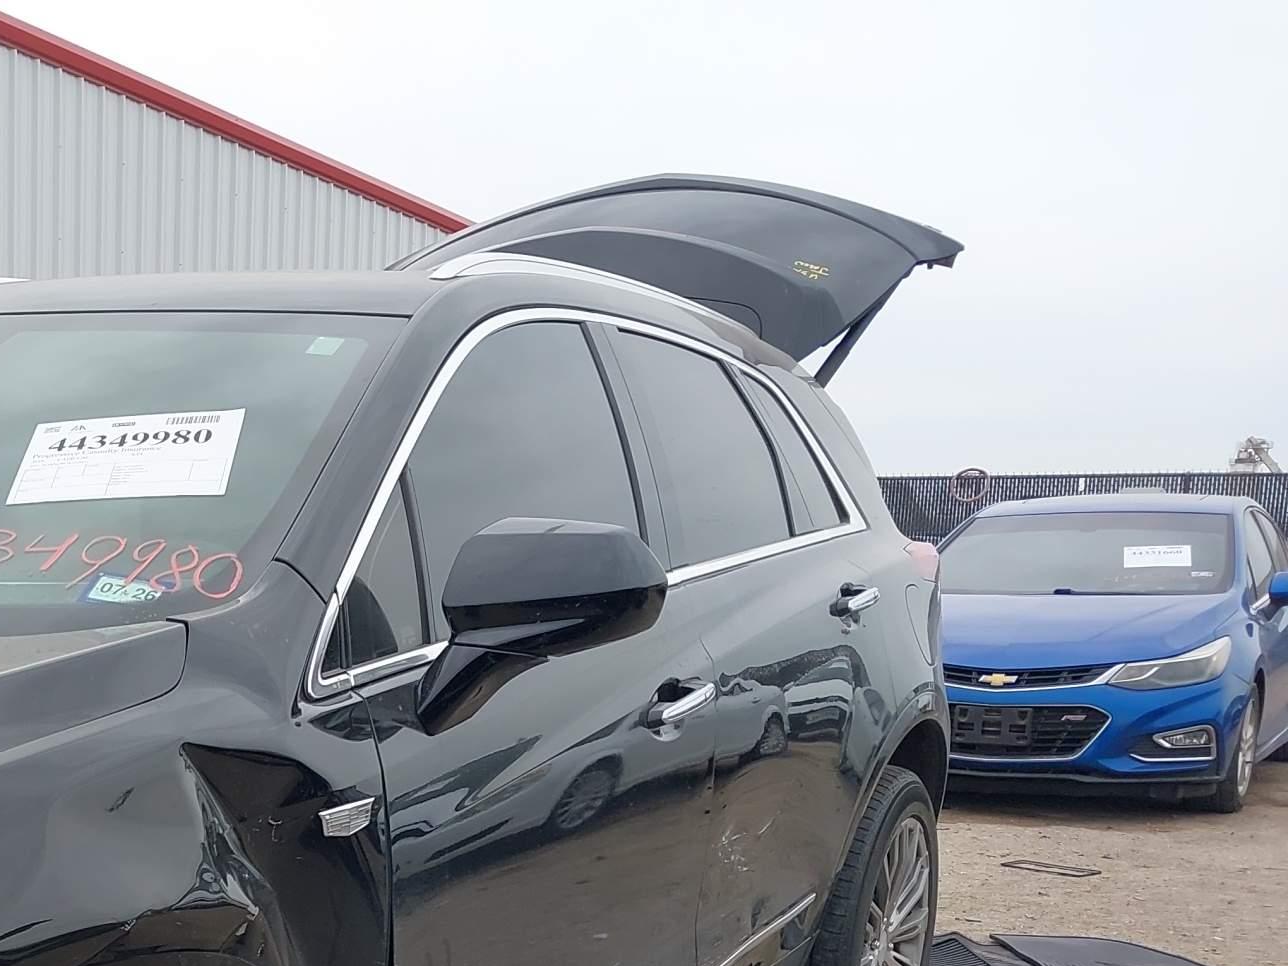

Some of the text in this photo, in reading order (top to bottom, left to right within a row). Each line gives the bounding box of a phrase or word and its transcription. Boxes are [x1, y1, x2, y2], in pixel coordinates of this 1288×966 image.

[48, 429, 213, 452] 44349980
[99, 582, 158, 600] 07 26
